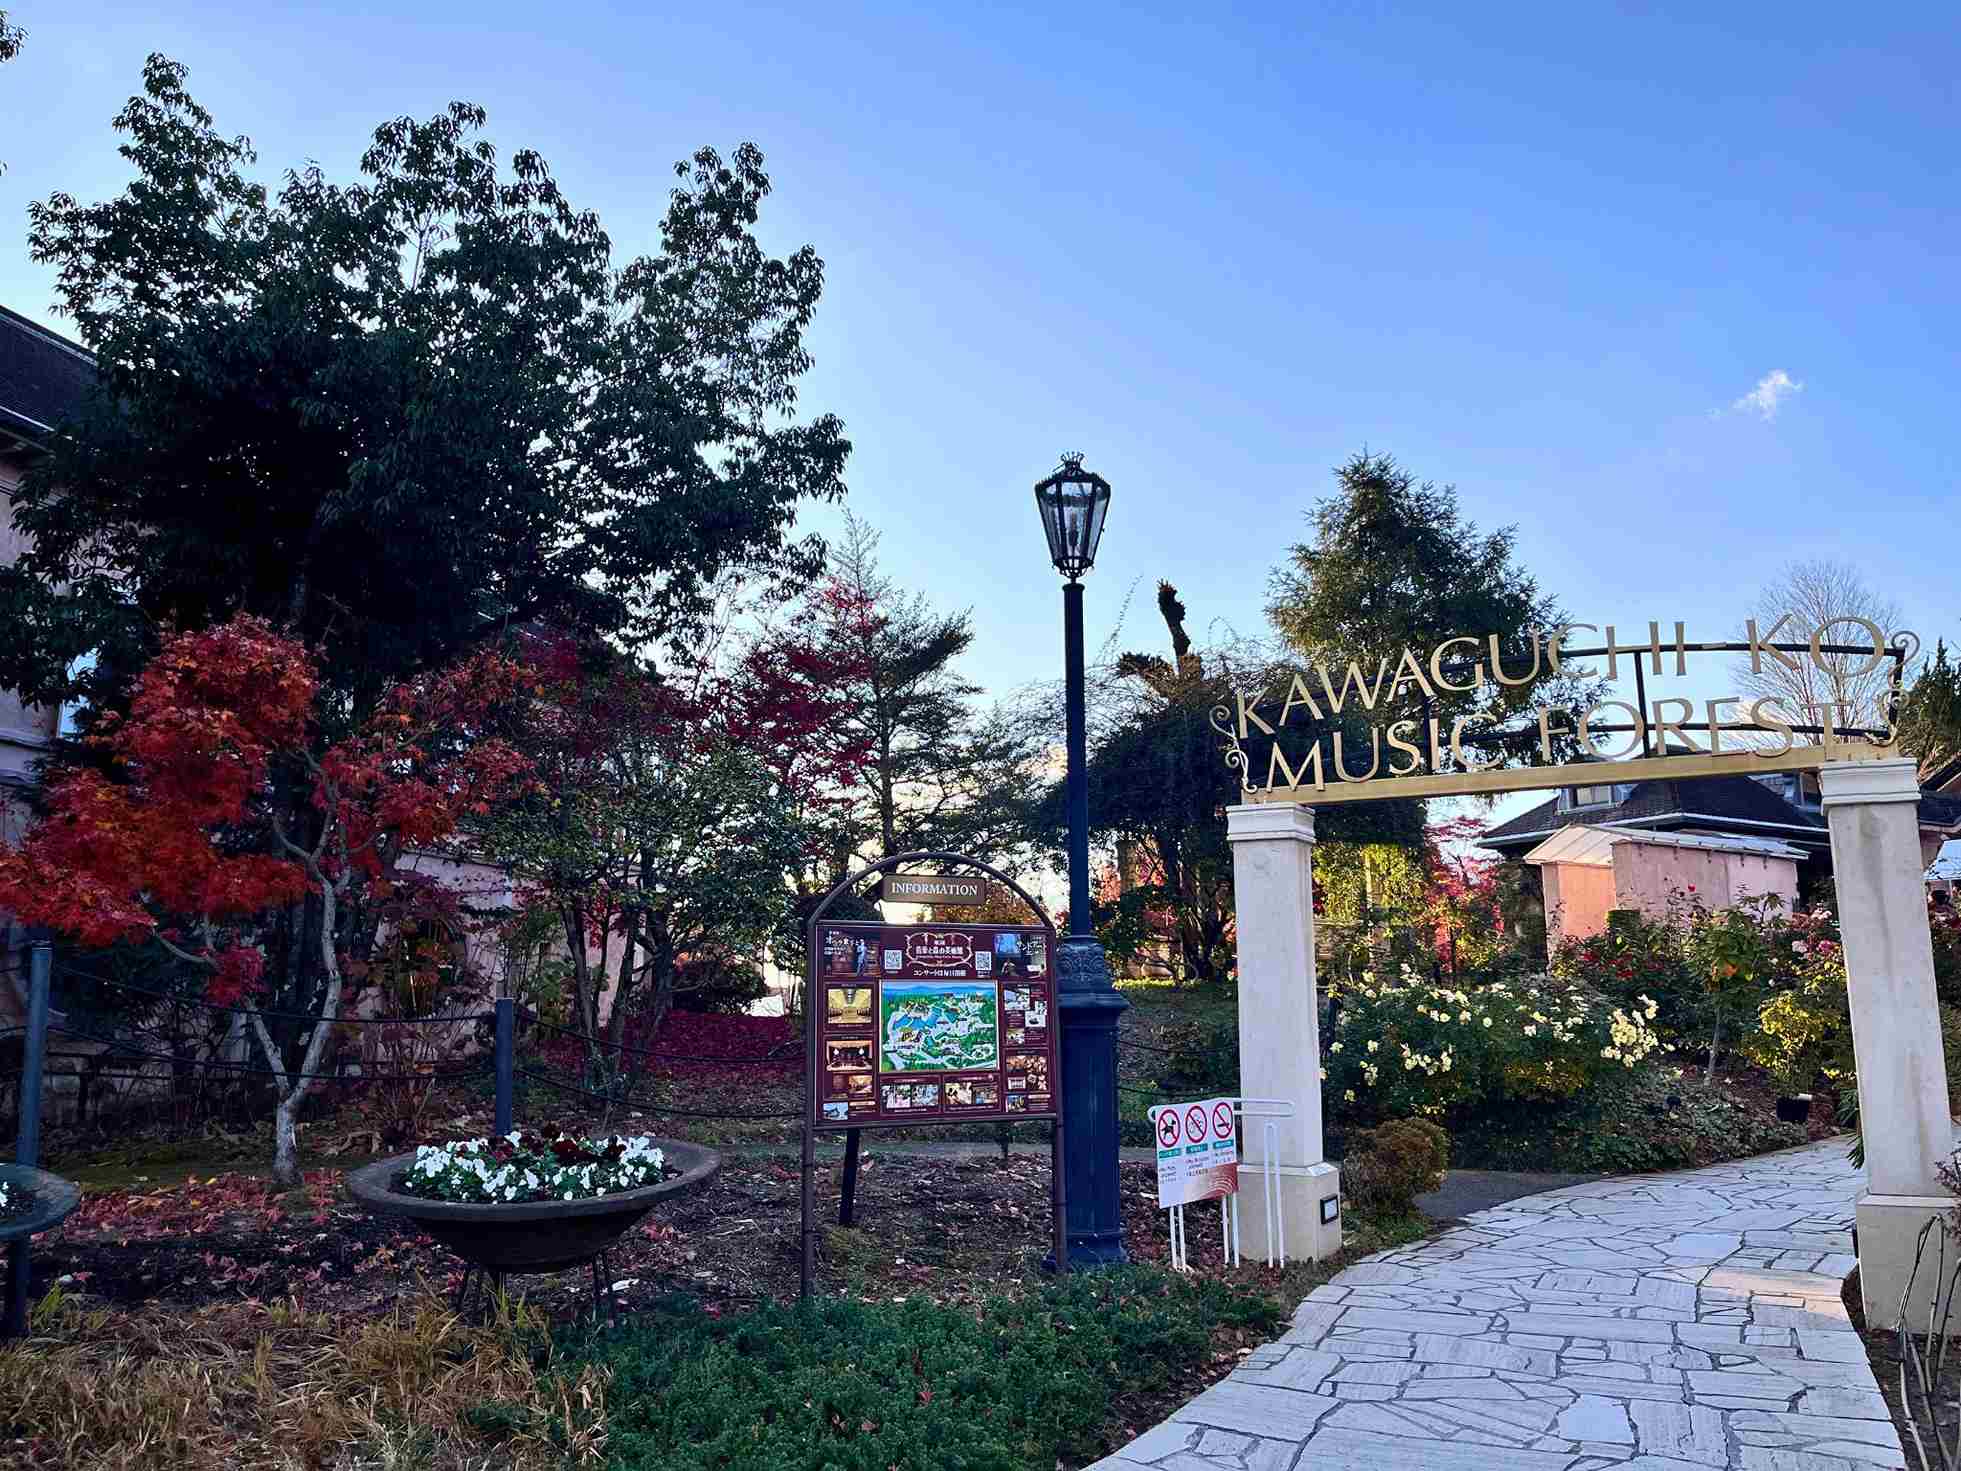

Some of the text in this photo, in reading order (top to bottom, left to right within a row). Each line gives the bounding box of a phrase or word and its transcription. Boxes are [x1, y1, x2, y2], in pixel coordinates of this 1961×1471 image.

[1265, 696, 1857, 793] MUSIC FOREST
[891, 882, 978, 897] INFORMATION
